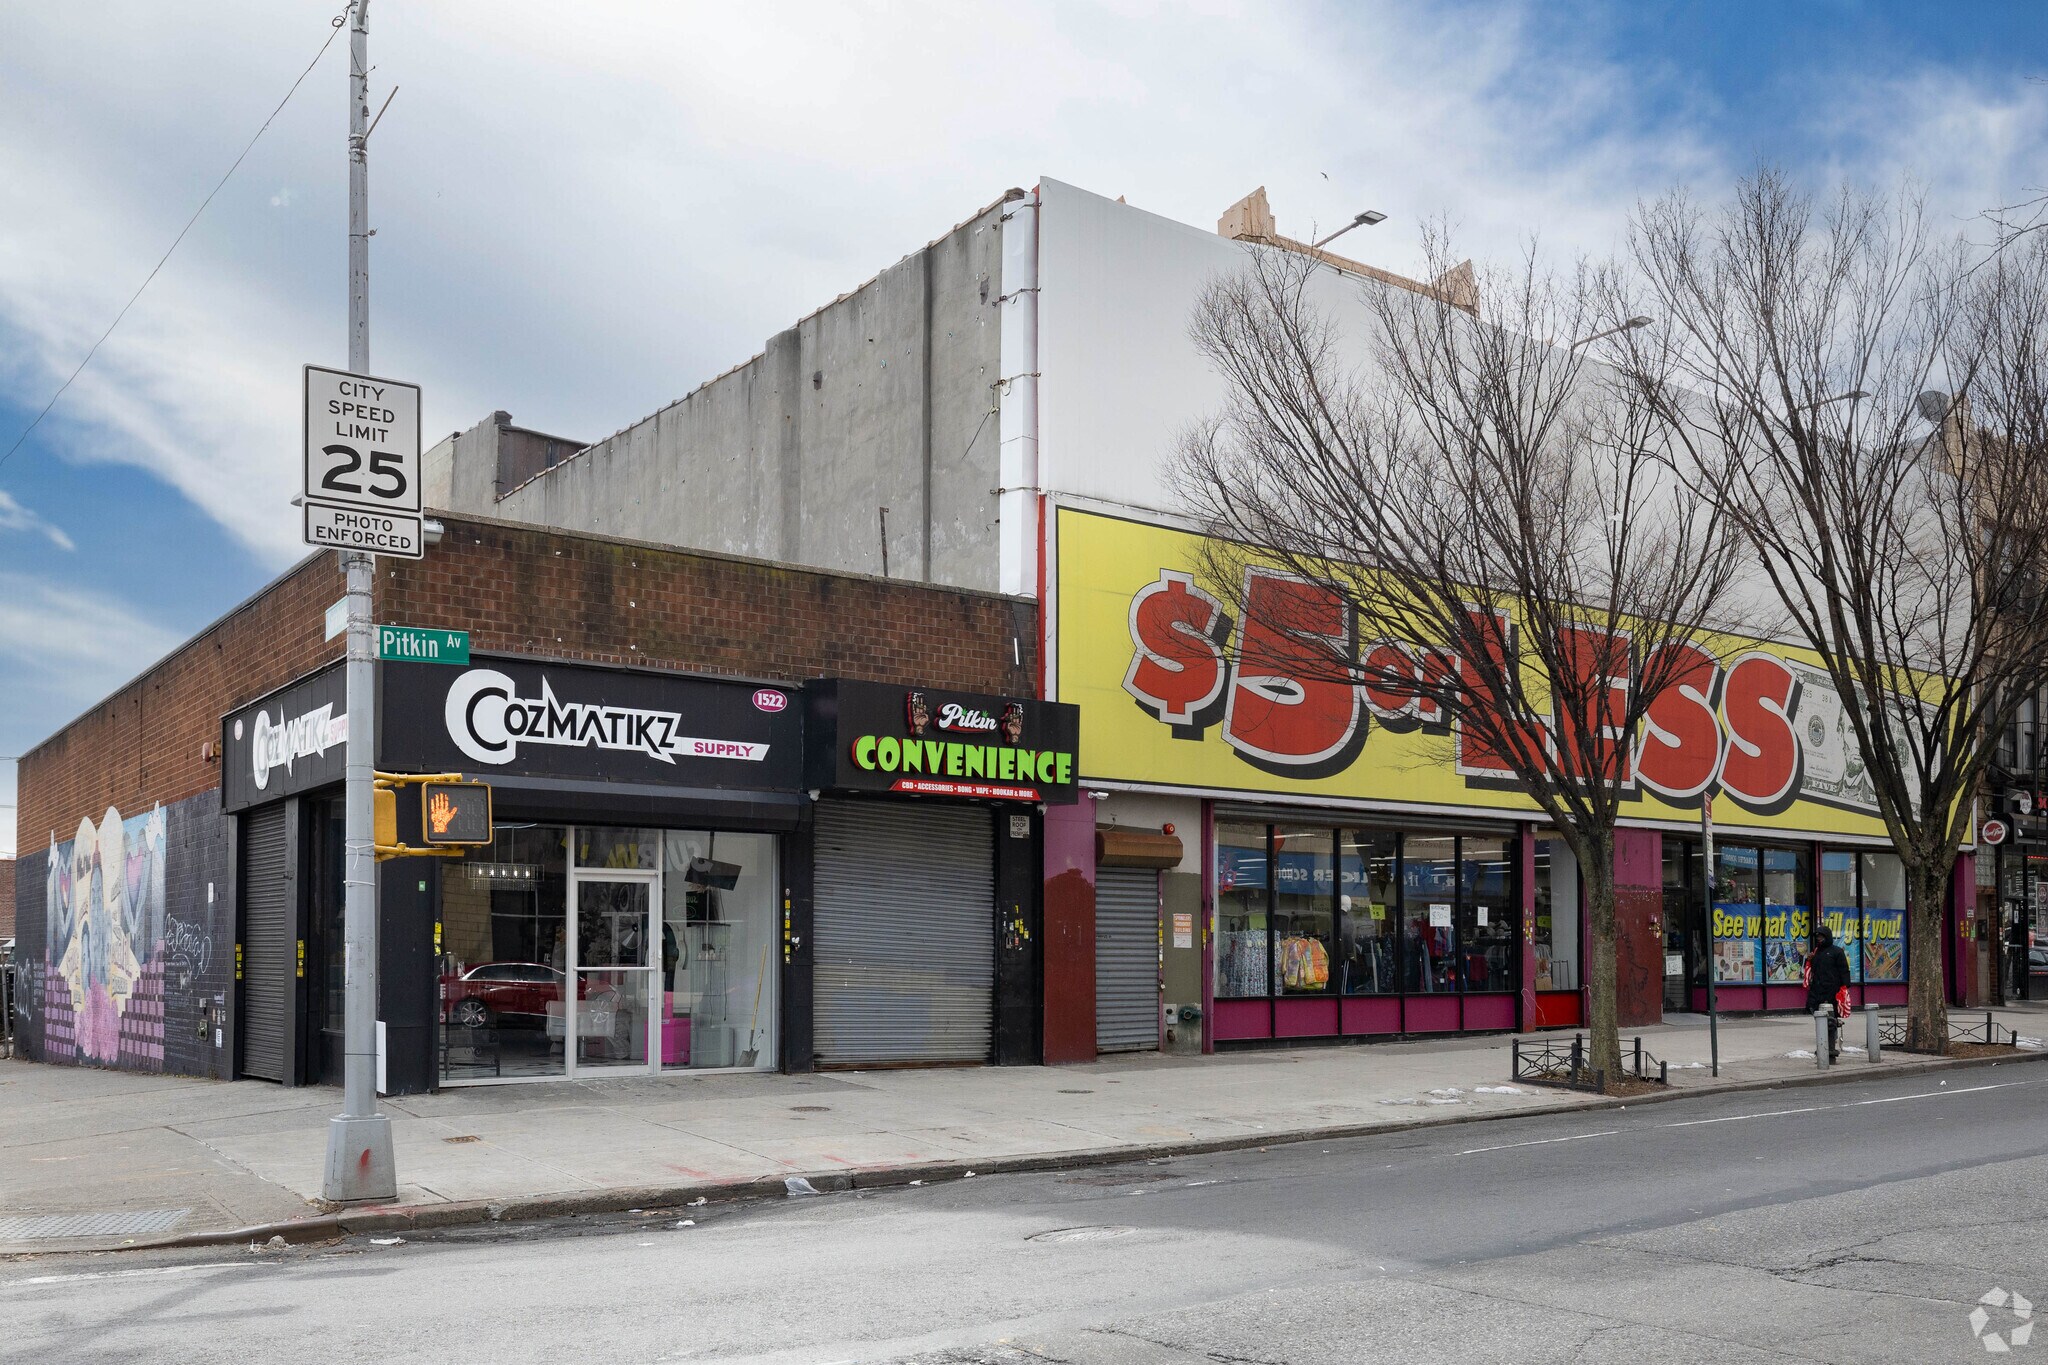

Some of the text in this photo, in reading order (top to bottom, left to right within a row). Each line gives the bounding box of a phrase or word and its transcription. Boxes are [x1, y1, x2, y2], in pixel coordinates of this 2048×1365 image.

[339, 381, 385, 401] CITY
[328, 400, 395, 423] SPEED
[336, 421, 389, 443] LIMIT
[321, 444, 407, 499] 25
[334, 512, 393, 532] PHOTO
[316, 525, 411, 549] ENFORCED
[383, 630, 461, 658] Pitkin Av
[1121, 564, 1362, 766] $5
[1455, 602, 1798, 805] LESS
[757, 692, 787, 709] 1522
[937, 703, 998, 732] Pitkin
[694, 741, 754, 758] SUPPLY
[854, 735, 1072, 785] CONVENIENCE
[901, 781, 914, 789] CBD
[917, 783, 954, 792] ACCESSORIES
[992, 788, 1014, 796] HOOKAH
[1019, 790, 1033, 798] MORE
[1713, 908, 1744, 938] See
[1790, 909, 1811, 940] $5
[1823, 911, 1843, 938] ill
[1844, 914, 1870, 945] get
[1872, 913, 1903, 944] you!
